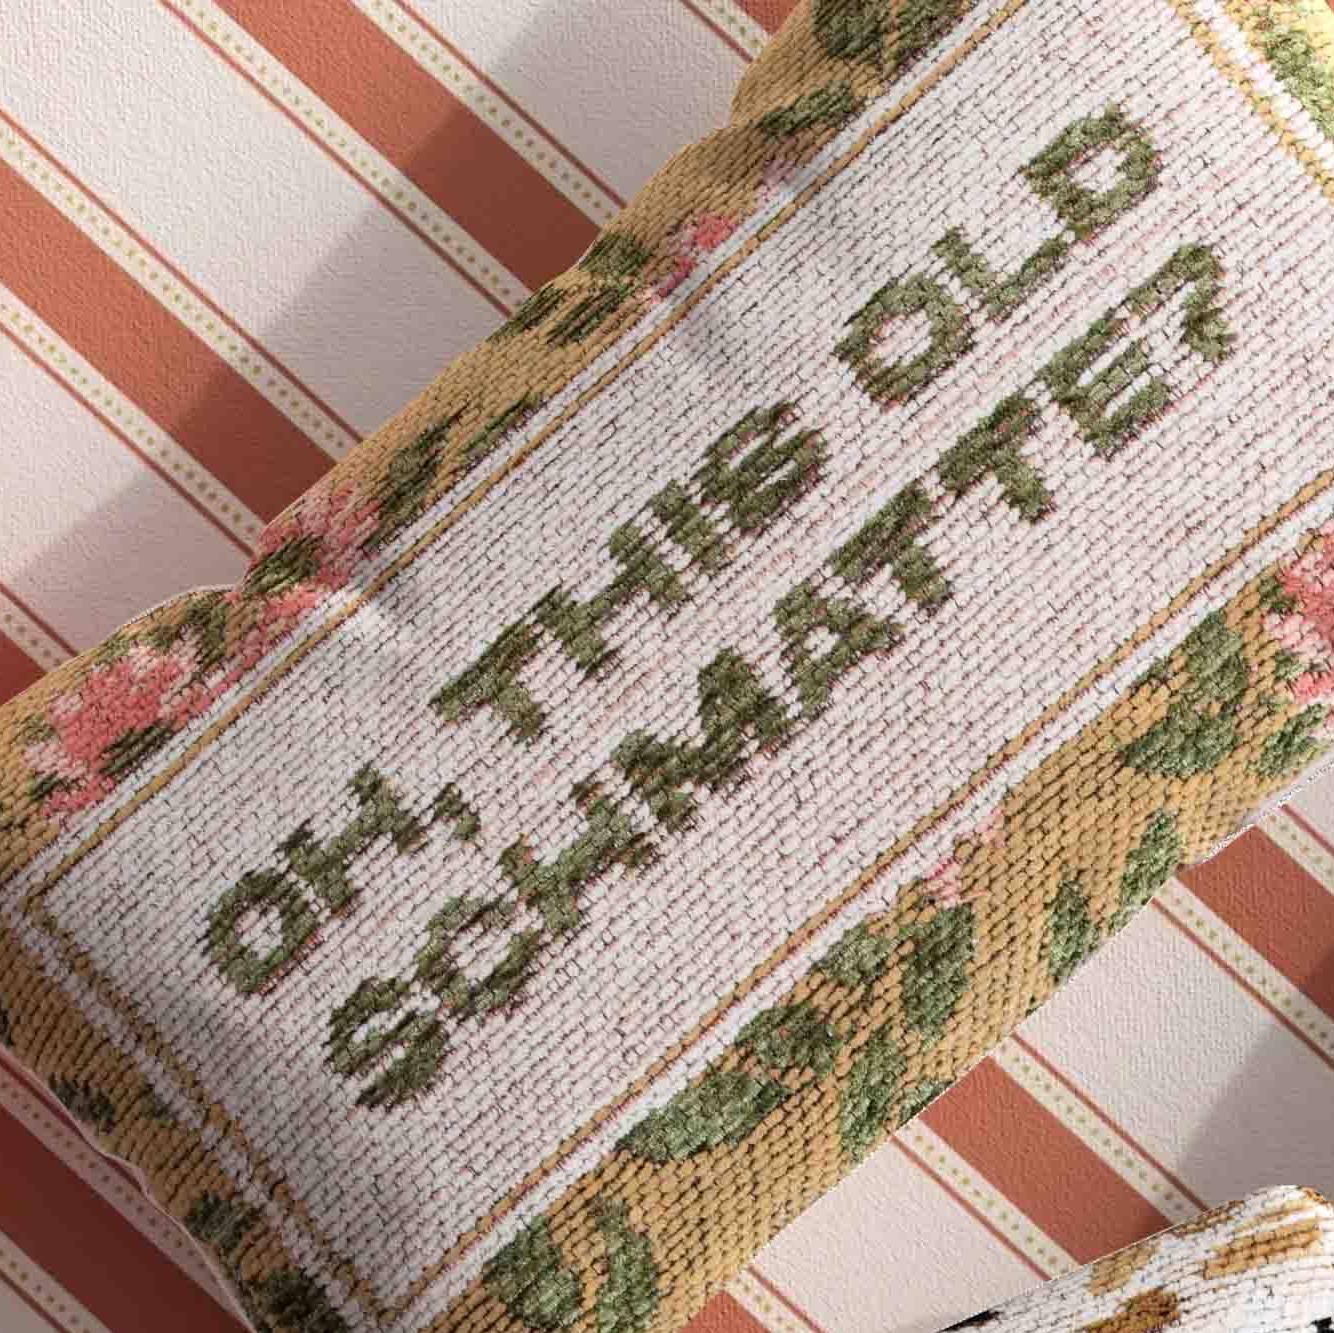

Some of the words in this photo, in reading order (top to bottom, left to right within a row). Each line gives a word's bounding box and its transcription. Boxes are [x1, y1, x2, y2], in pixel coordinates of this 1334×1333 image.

[325, 243, 1237, 1111] SCHMATTE?
[429, 400, 832, 743] THIS
[835, 102, 1165, 407] OLD
